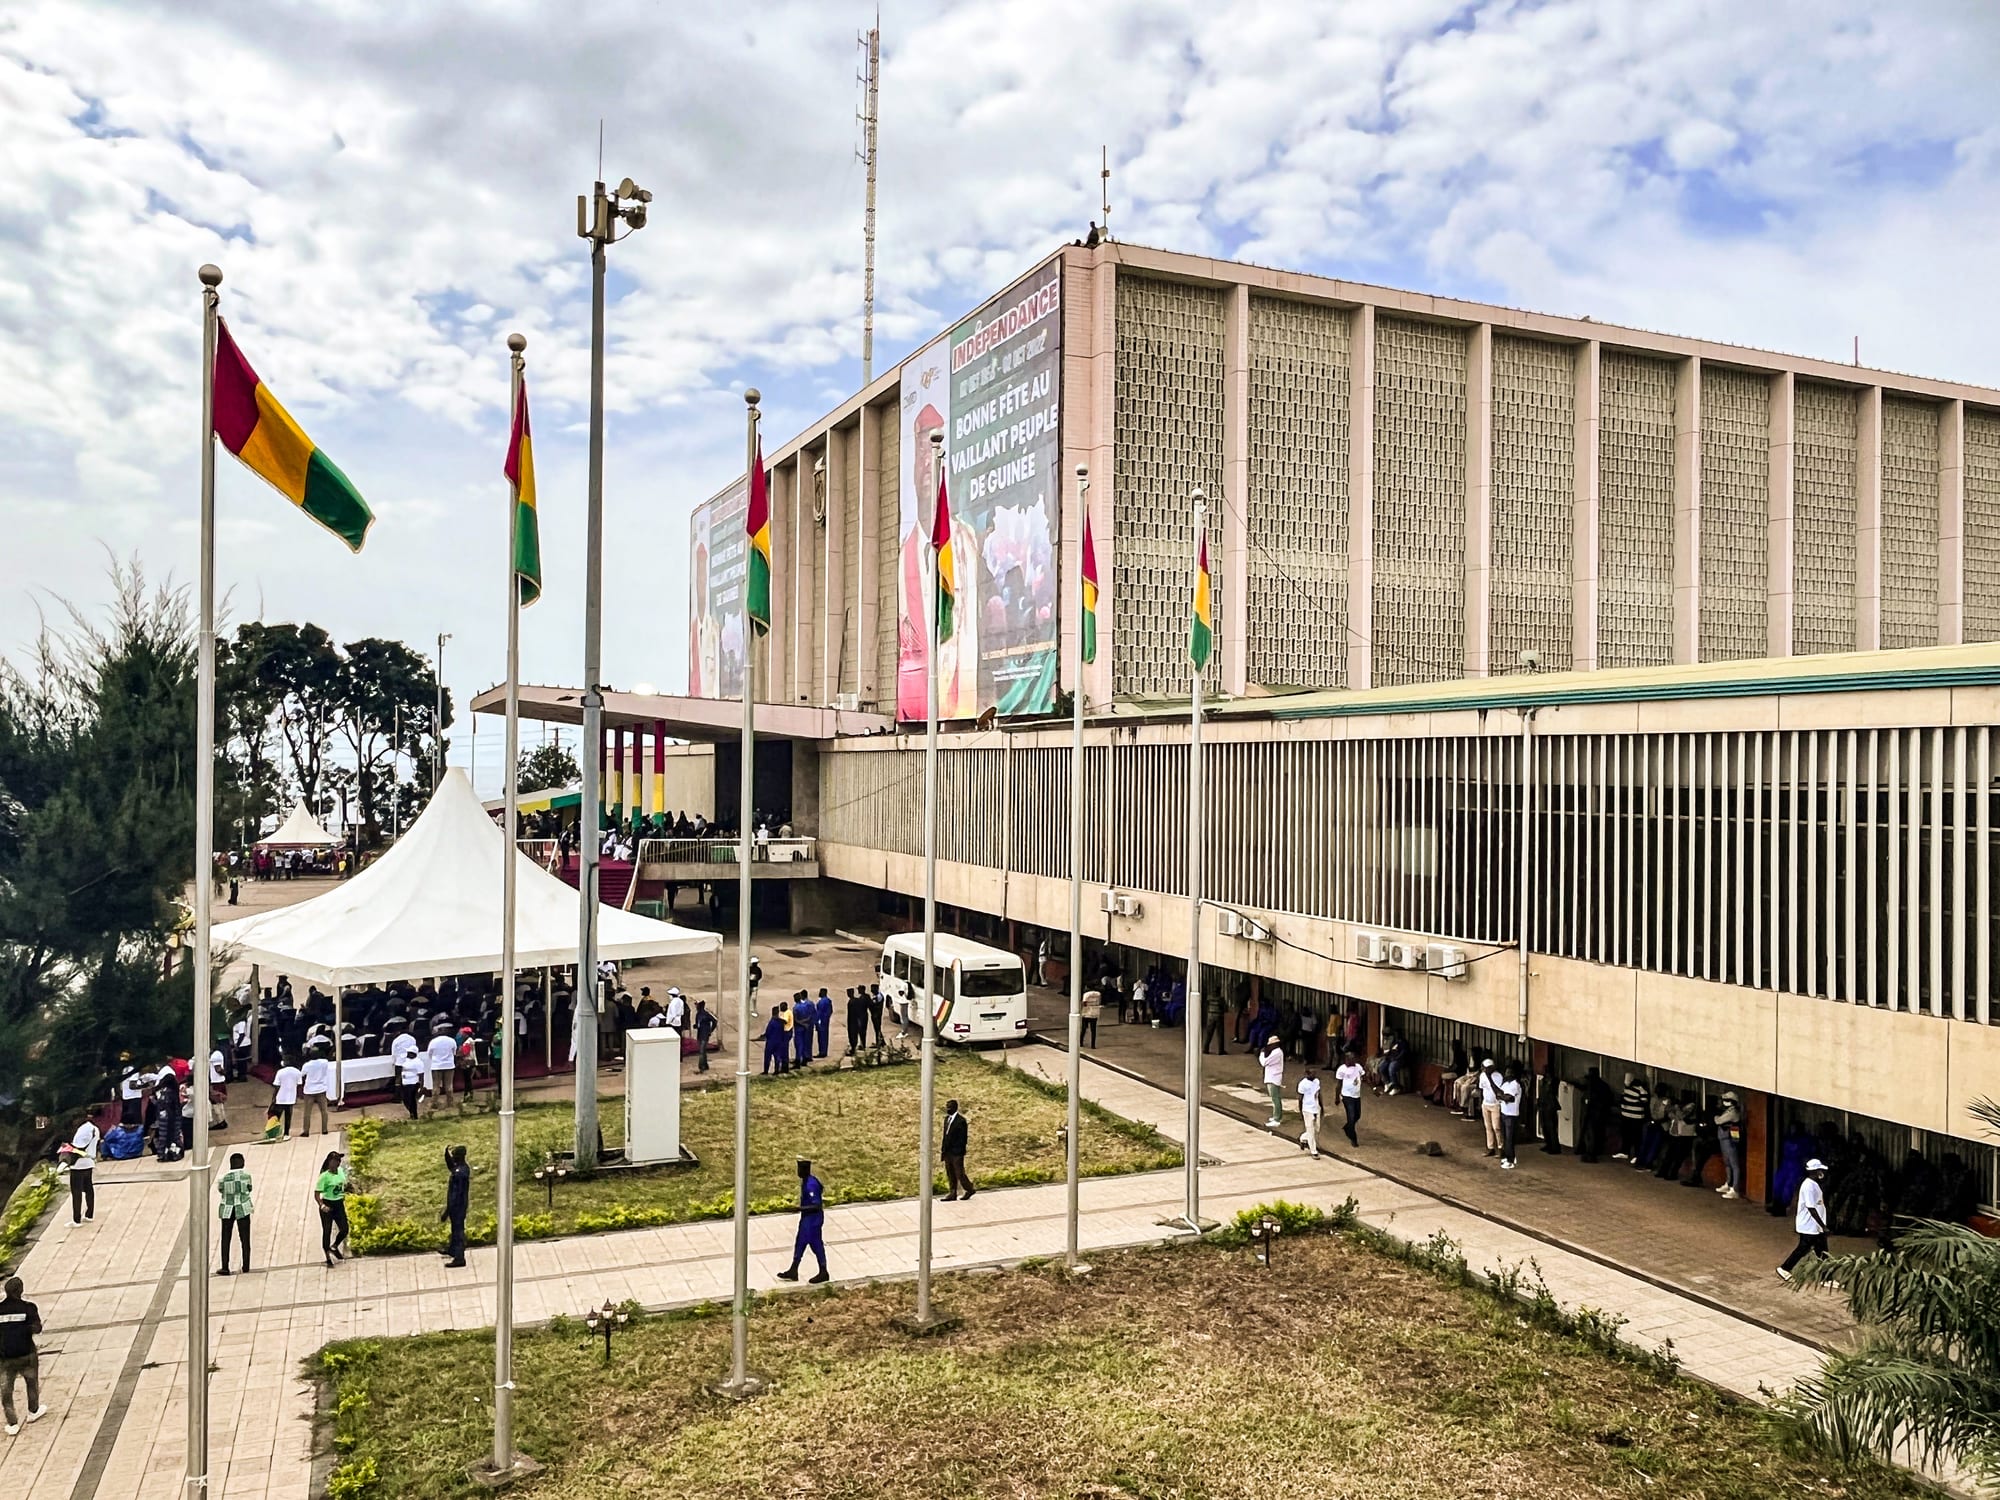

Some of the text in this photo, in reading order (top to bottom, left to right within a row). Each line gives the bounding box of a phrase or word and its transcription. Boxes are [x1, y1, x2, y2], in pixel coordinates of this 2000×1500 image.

[951, 403, 1058, 475] VAILLANT PEUPLE
[956, 399, 997, 440] BONNE
[999, 382, 1029, 418] FÊTE
[1030, 369, 1050, 402] AU
[970, 447, 1036, 501] DE GUINÉE
